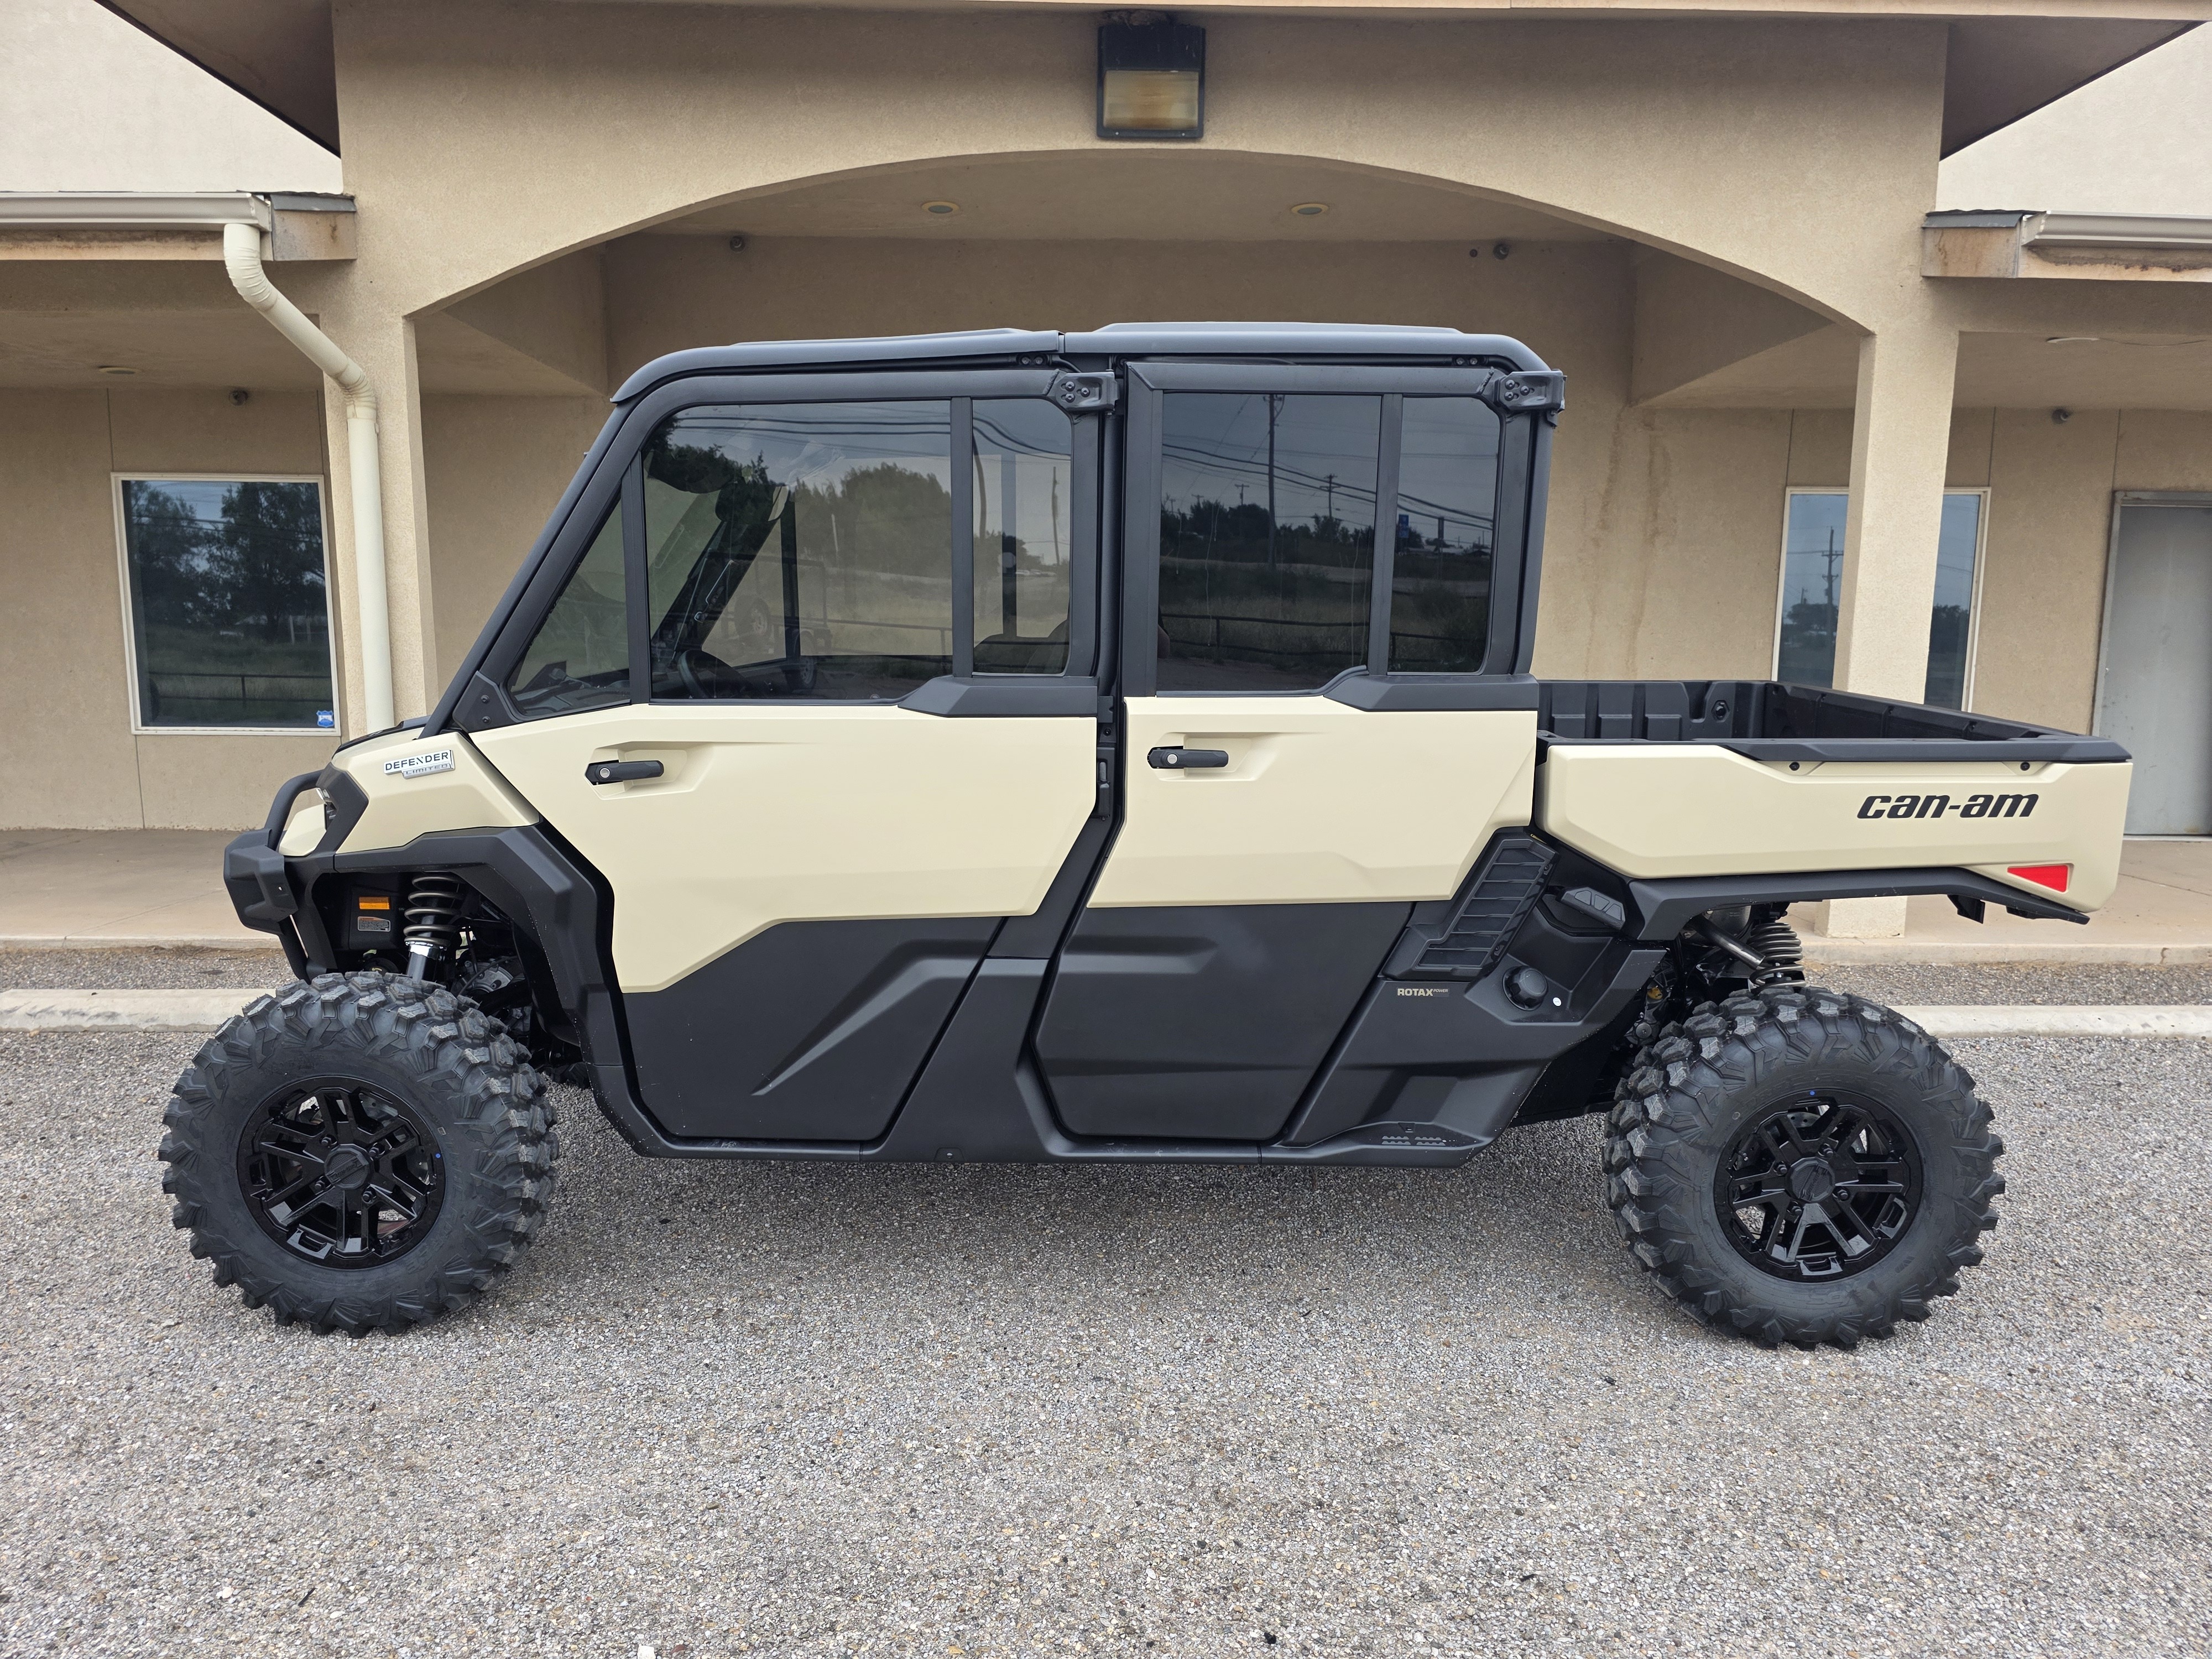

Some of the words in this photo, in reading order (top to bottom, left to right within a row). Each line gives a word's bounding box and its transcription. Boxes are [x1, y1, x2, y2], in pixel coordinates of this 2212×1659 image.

[385, 752, 449, 771] DEFENDER
[406, 764, 448, 775] LIMITED
[1856, 794, 2039, 819] can-am
[1397, 988, 1433, 997] ROTAX
